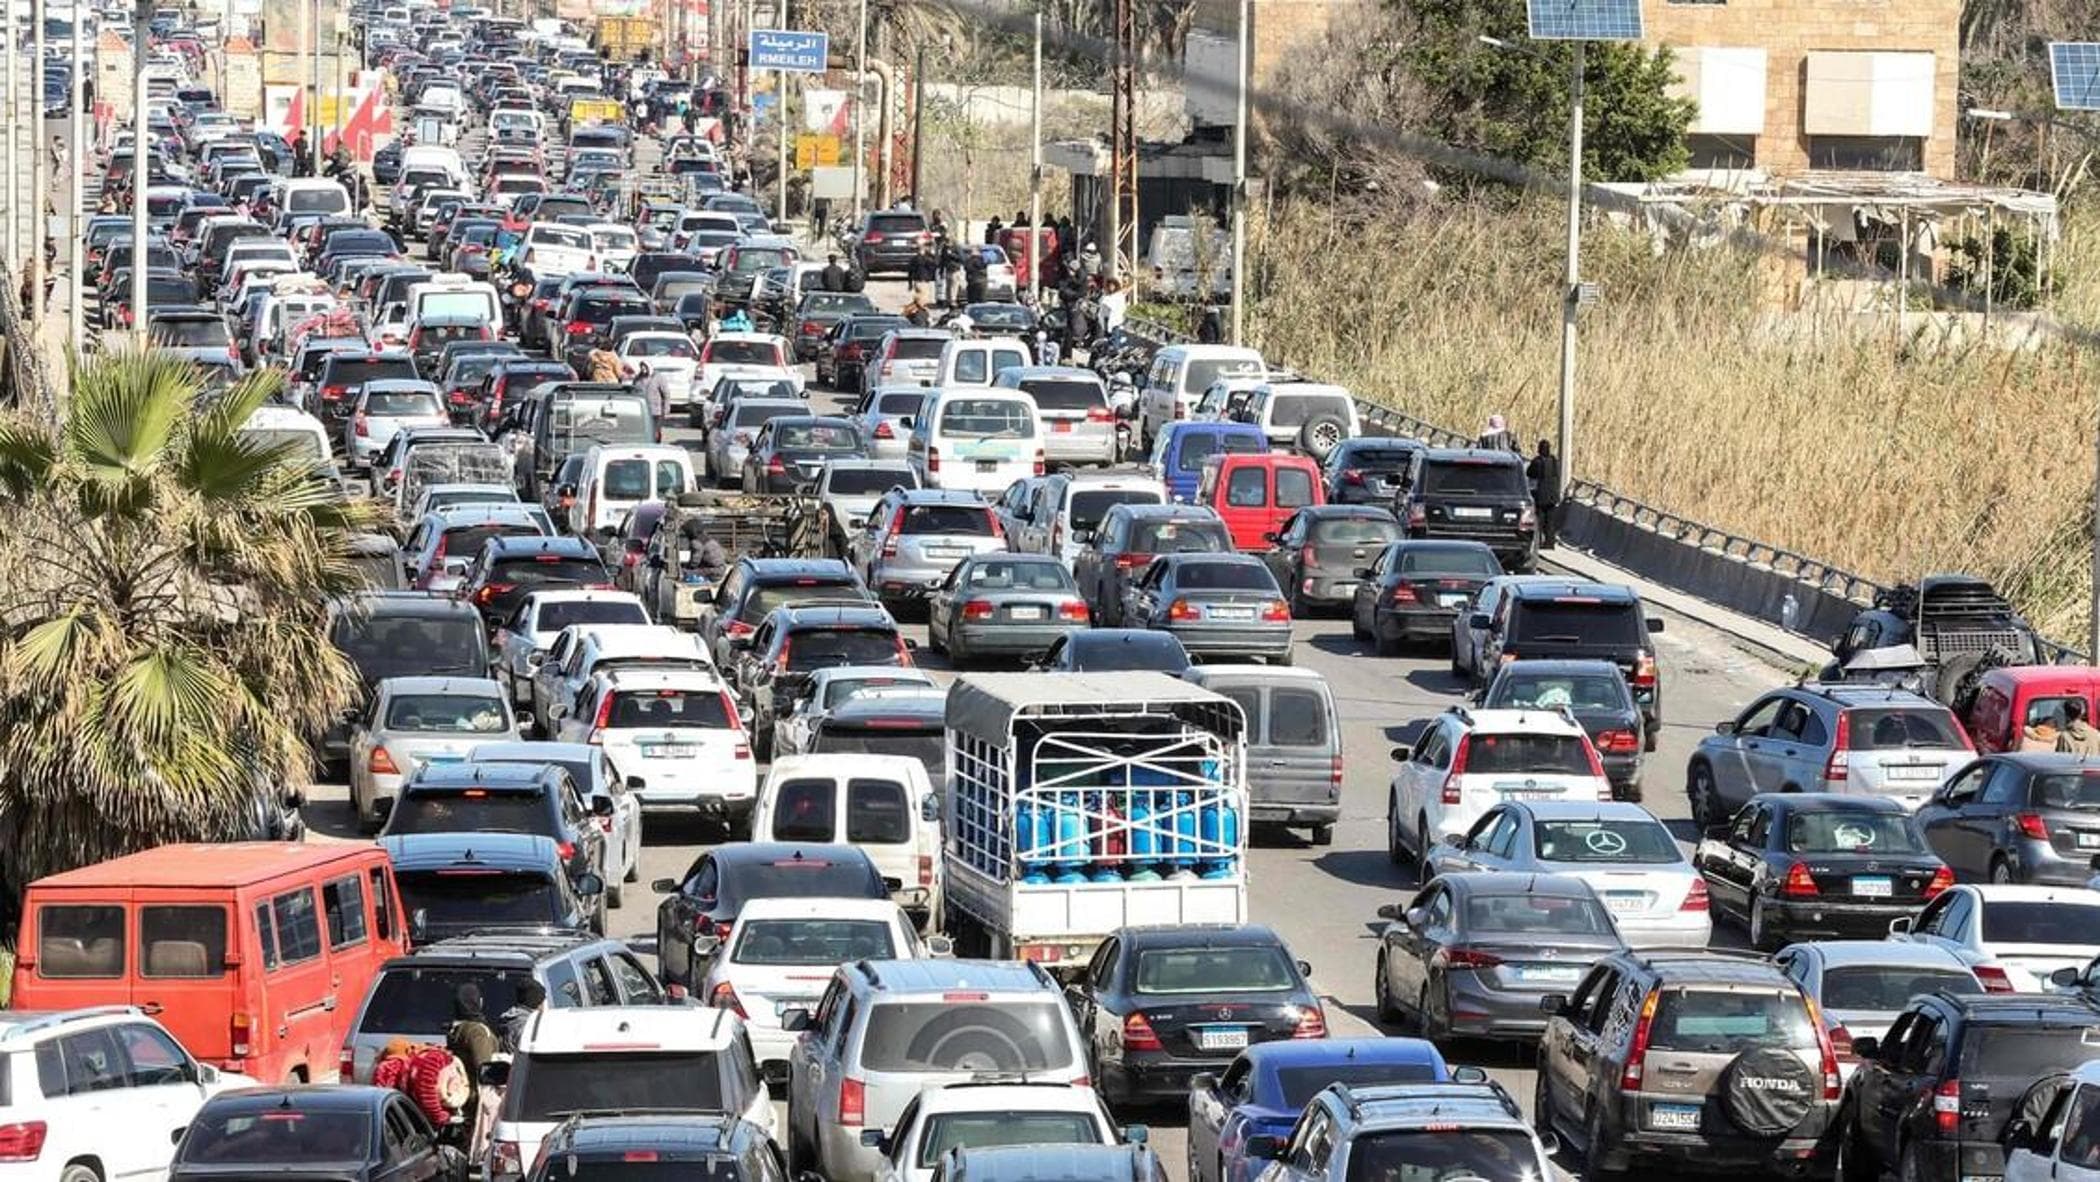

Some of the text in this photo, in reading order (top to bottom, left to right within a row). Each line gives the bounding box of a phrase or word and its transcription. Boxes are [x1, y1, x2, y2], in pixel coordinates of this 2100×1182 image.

[758, 34, 817, 51] الرميلة
[758, 53, 817, 66] RMEILEH
[1740, 1077, 1800, 1090] HONDA
